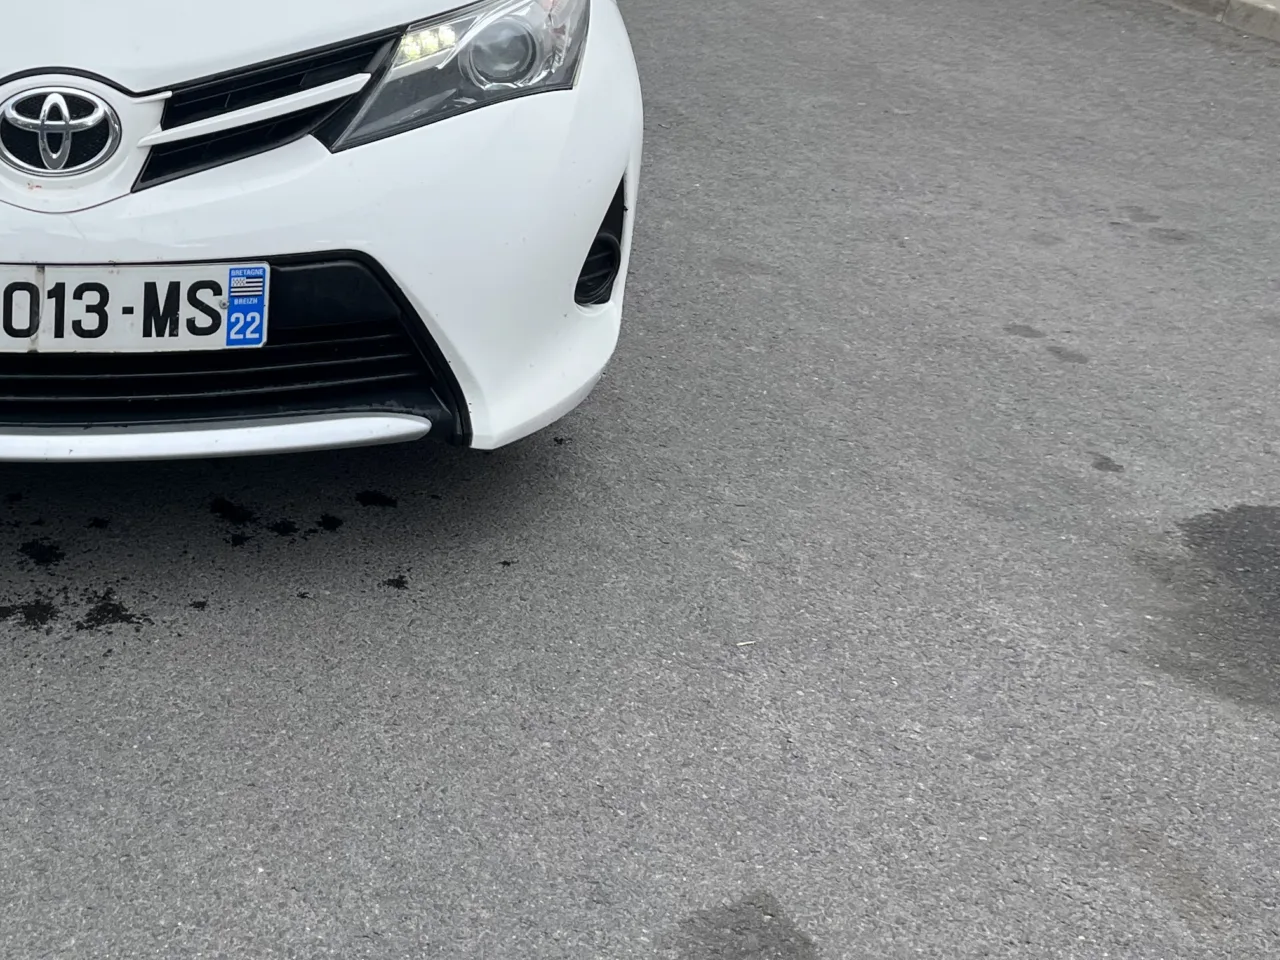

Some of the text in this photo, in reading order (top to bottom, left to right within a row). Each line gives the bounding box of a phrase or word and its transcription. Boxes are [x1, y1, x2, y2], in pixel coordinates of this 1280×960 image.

[230, 268, 264, 276] BRETAGNE
[233, 297, 258, 305] BREIZH
[229, 312, 261, 339] 22
